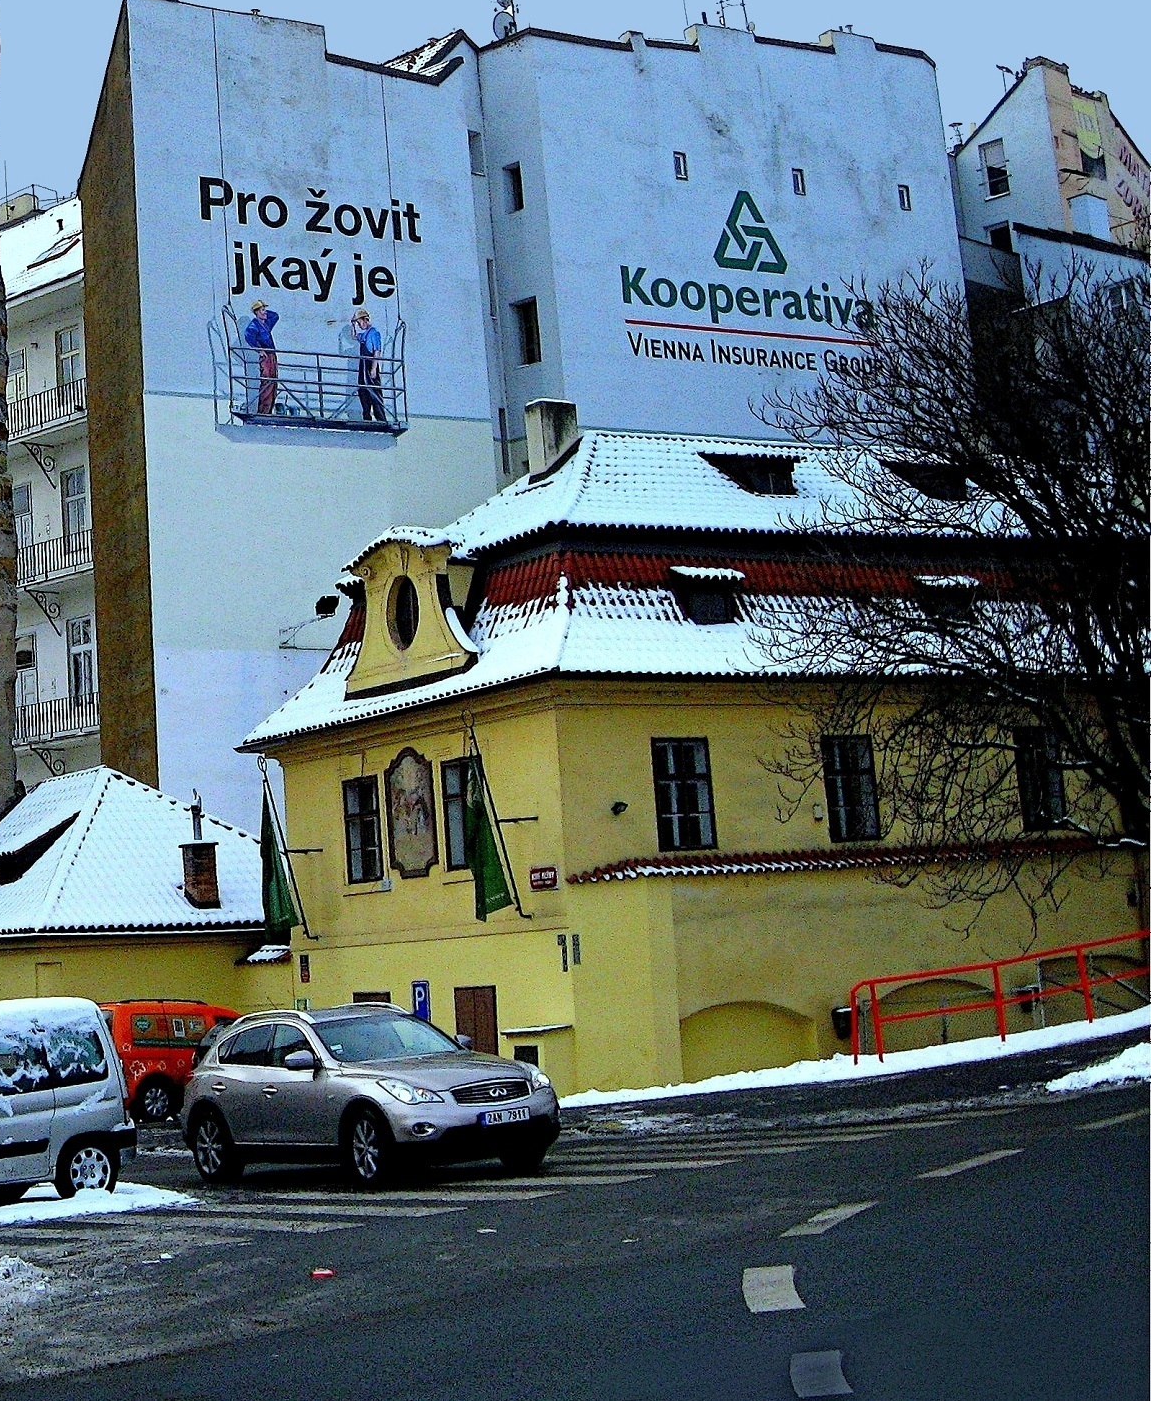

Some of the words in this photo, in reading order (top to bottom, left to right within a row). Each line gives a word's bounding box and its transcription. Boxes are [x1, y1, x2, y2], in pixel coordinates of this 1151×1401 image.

[199, 176, 288, 228] Pro
[305, 187, 422, 243] žovit
[231, 240, 337, 302] jkaý
[352, 253, 395, 305] je
[620, 265, 877, 330] Kooperativa
[415, 986, 425, 1010] P
